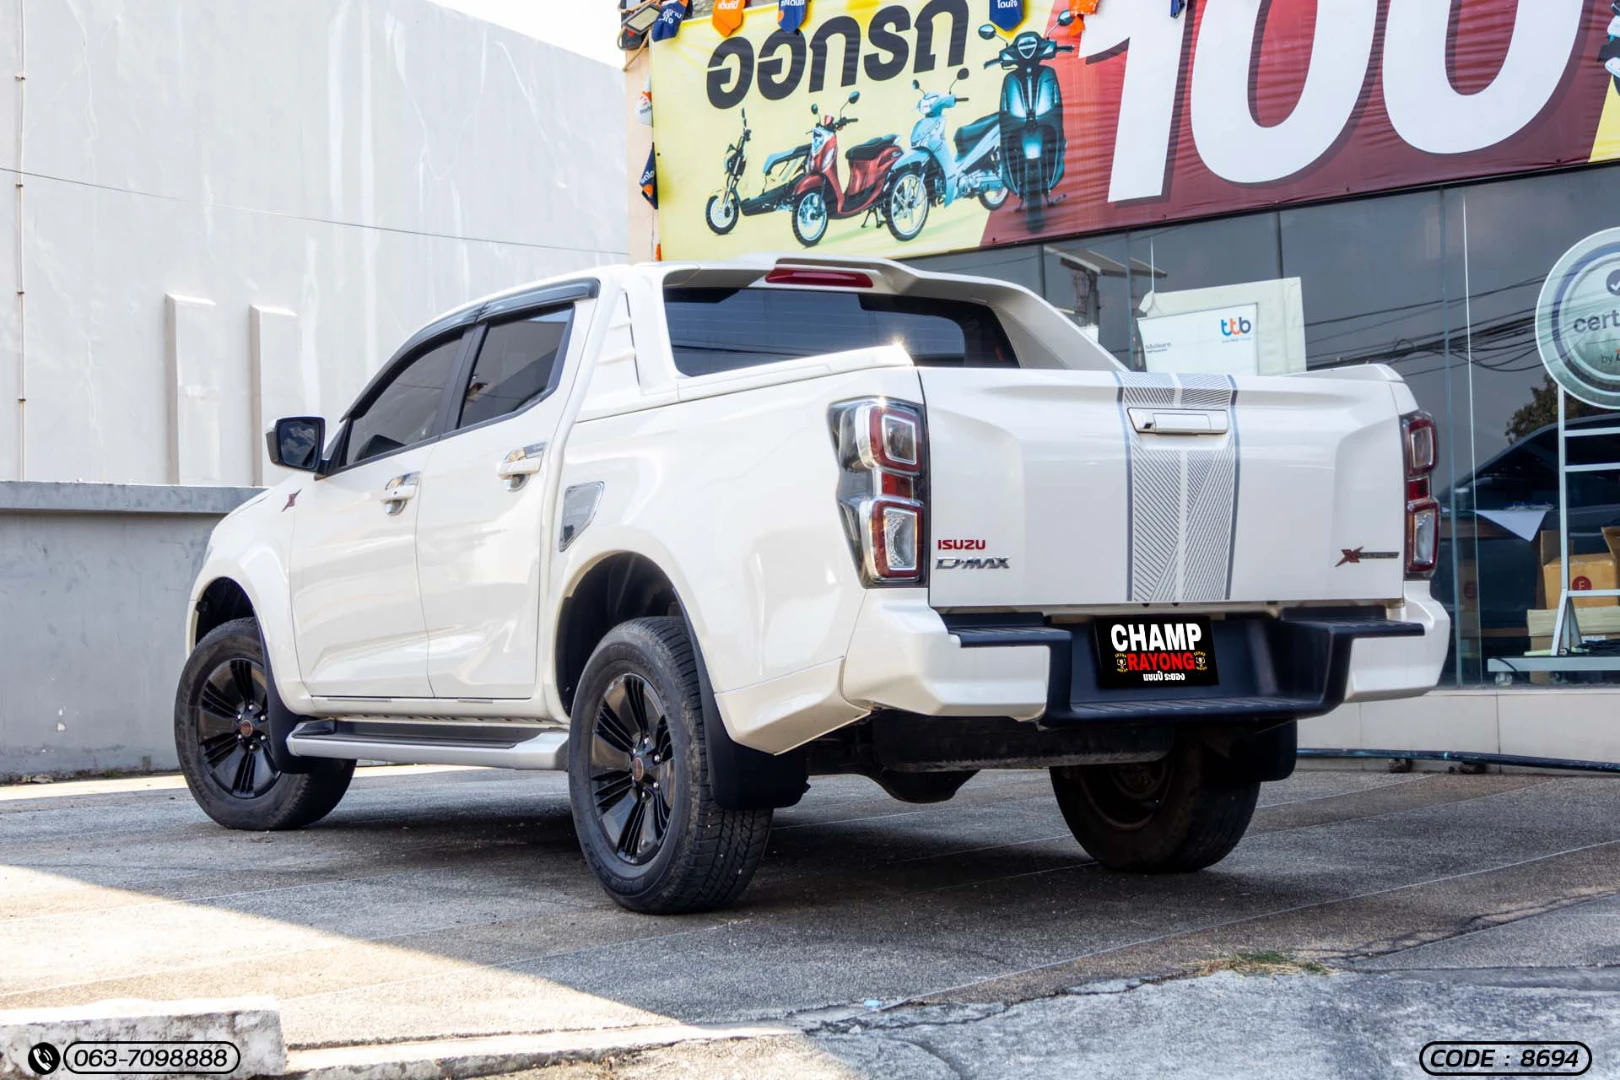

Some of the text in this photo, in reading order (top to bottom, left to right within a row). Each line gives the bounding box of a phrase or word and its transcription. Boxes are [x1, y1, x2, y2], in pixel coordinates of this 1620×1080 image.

[706, 0, 969, 110] ออกรถ
[1220, 316, 1252, 336] ttb
[937, 539, 986, 550] ISUZU
